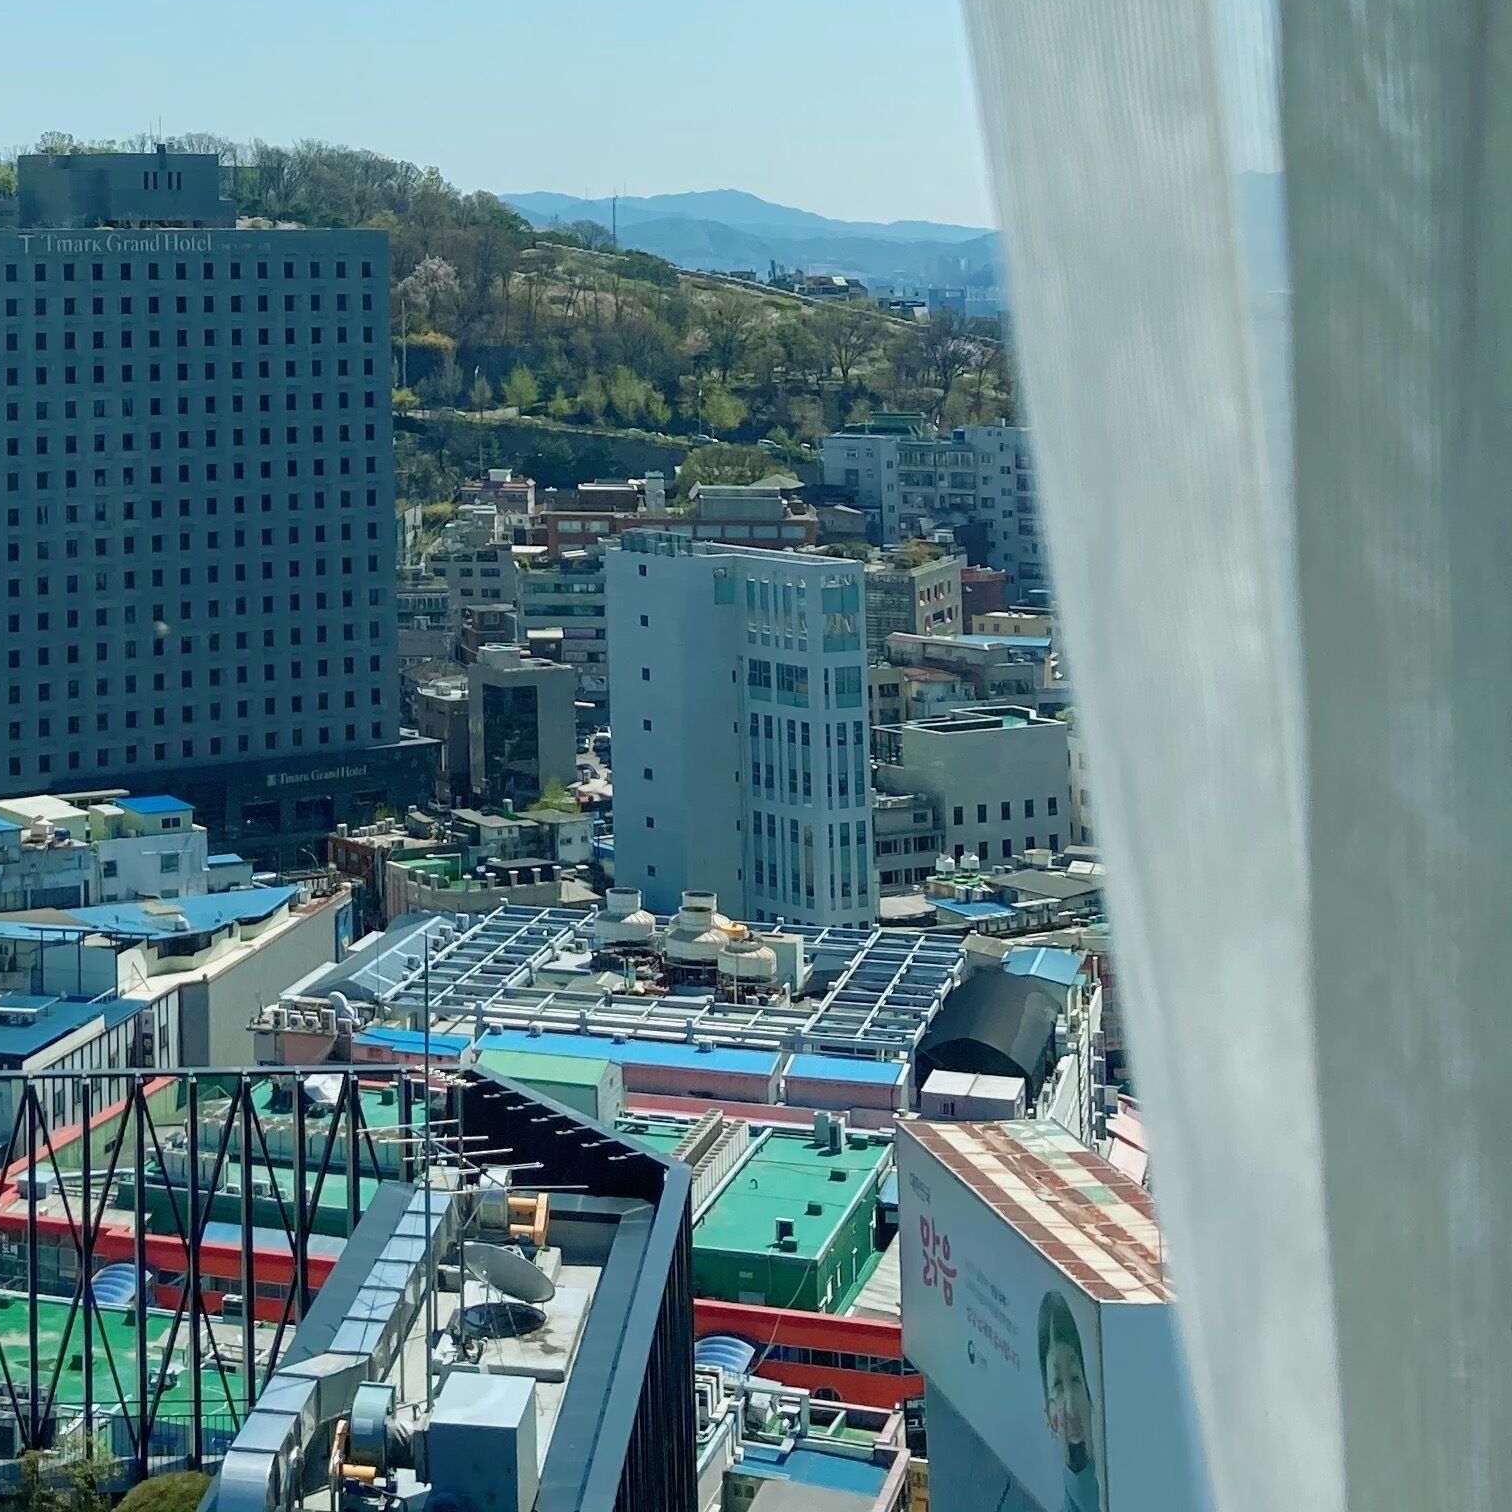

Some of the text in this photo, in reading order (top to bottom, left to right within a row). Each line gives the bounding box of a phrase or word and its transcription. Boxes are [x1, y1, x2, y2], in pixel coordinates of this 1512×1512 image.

[41, 233, 102, 253] Tmark
[106, 232, 159, 252] Grand
[164, 232, 212, 252] Hotel
[311, 767, 339, 781] Grand
[340, 764, 367, 779] Hotel
[919, 1214, 958, 1307] 맑음
